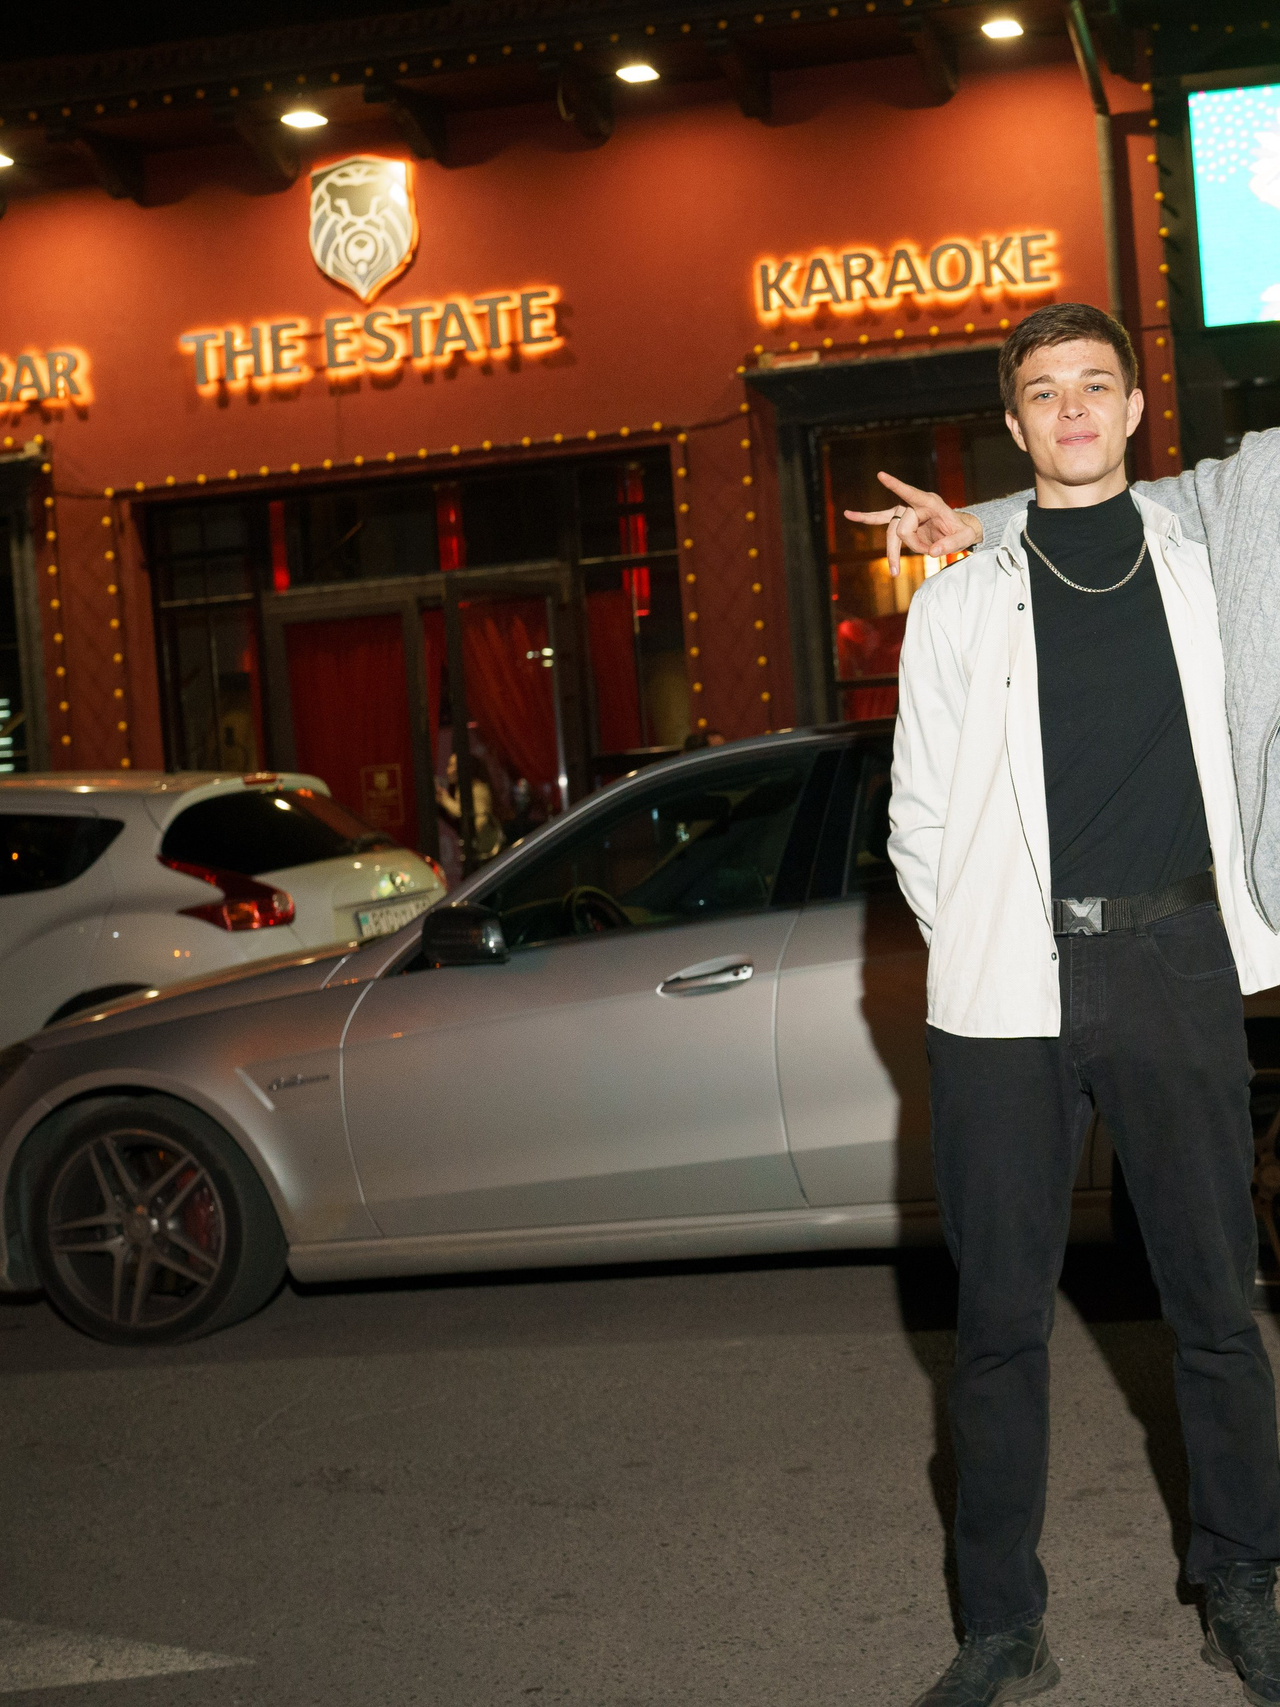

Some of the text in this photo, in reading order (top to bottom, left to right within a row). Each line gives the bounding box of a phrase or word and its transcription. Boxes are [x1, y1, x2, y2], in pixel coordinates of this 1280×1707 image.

[759, 233, 1052, 313] KARAOKE
[0, 351, 81, 402] AR
[181, 289, 557, 386] THE ESTATE
